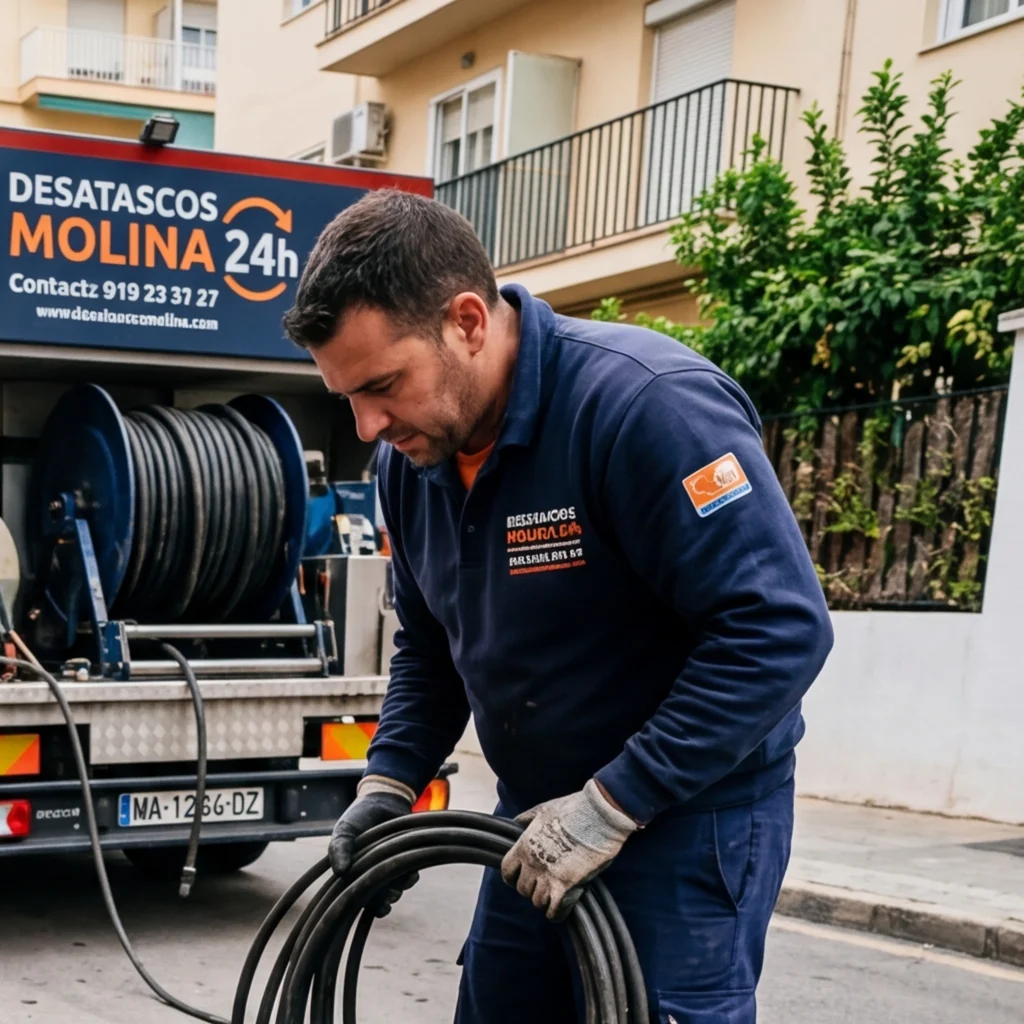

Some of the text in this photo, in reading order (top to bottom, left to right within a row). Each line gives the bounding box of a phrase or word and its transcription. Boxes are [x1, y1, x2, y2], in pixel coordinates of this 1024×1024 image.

[9, 172, 218, 222] DESATASCOS
[10, 212, 298, 278] MOLINA 24h
[102, 280, 140, 302] 919
[143, 284, 166, 304] 23
[196, 289, 219, 308] 27
